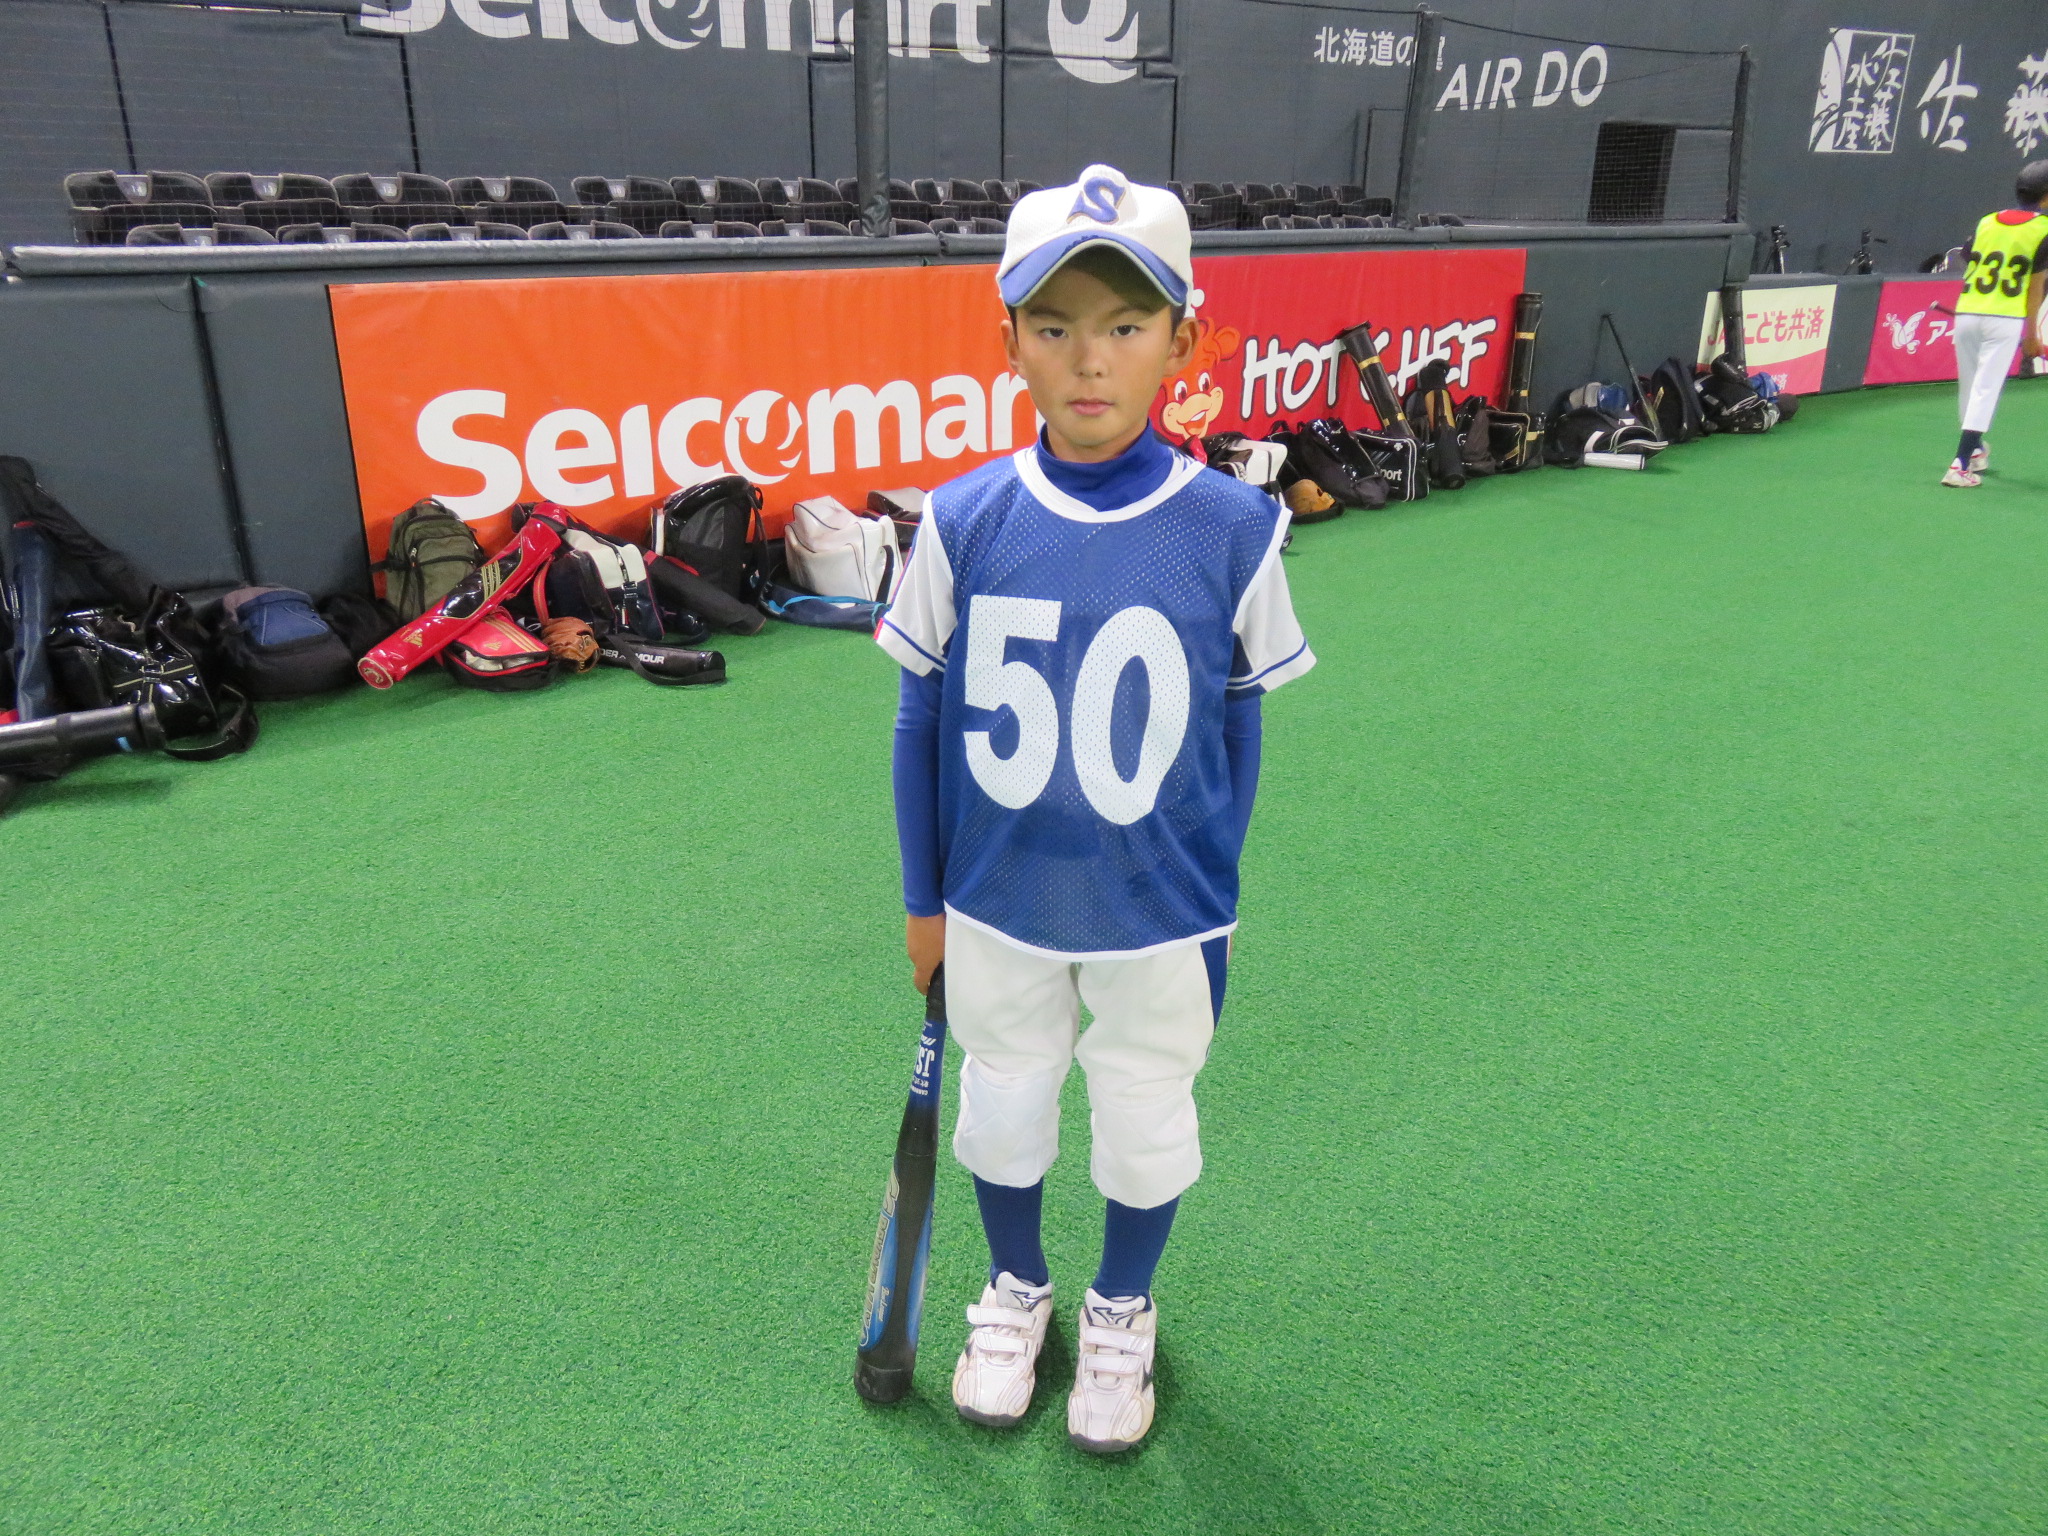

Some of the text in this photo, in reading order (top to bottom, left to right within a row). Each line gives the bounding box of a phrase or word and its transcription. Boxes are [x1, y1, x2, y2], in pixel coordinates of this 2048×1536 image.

[1314, 26, 1446, 71] 北海道の
[1434, 45, 1608, 111] AIR DO
[1066, 176, 1126, 225] S
[1240, 337, 1346, 419] HOT
[417, 371, 1041, 521] Seicomar
[1380, 469, 1403, 482] port
[963, 594, 1190, 826] 50
